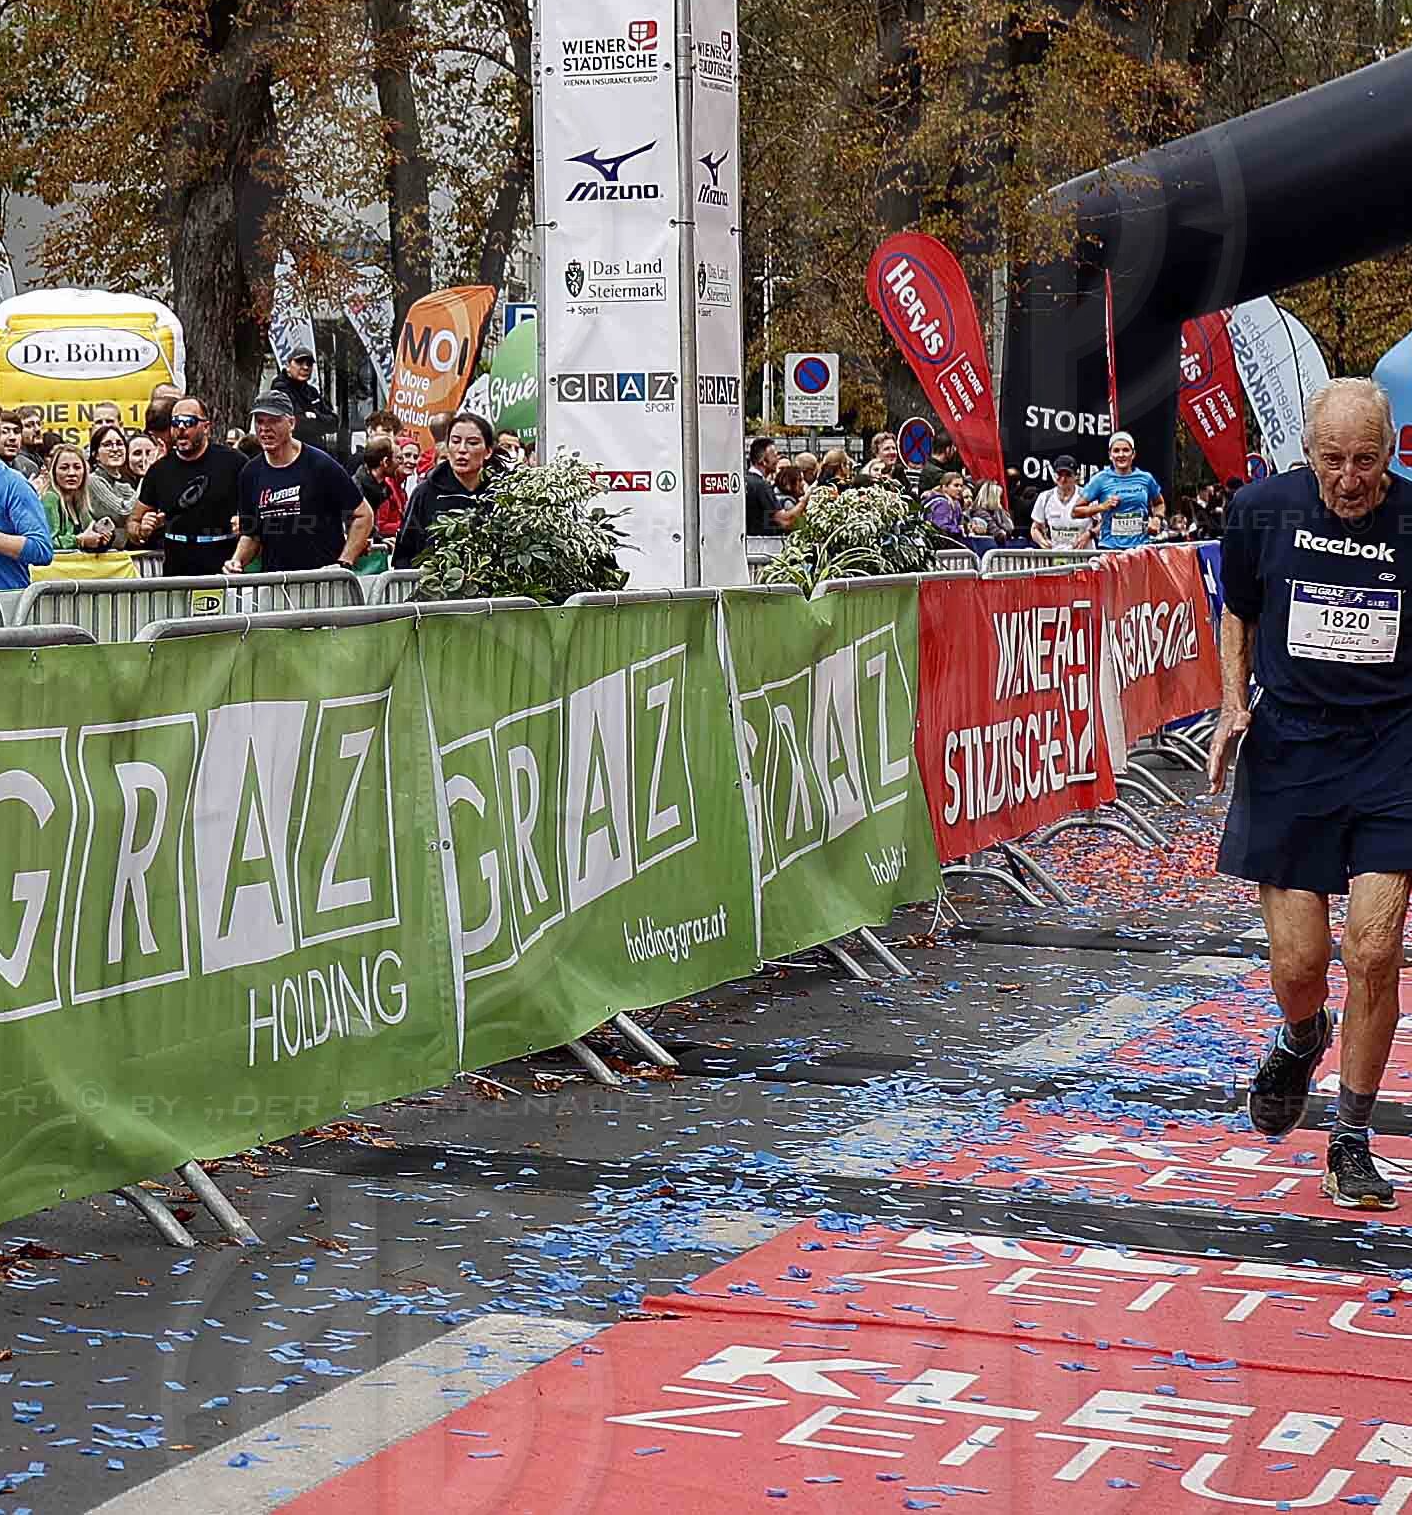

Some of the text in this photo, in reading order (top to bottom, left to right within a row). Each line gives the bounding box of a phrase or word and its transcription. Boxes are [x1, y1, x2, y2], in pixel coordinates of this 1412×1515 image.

[561, 38, 626, 56] WIENER
[562, 52, 658, 72] STÄDTISCHE
[564, 180, 660, 203] MIZUNO
[592, 258, 663, 276] Das Land
[588, 282, 664, 299] Steiermark
[578, 305, 599, 316] Sport
[884, 258, 946, 357] Hervis
[22, 344, 60, 364] Dr.
[401, 323, 470, 376] MOI
[399, 370, 430, 390] Move
[561, 375, 672, 401] GRAZ
[960, 360, 984, 396] STORE
[948, 373, 975, 413] ONLINE
[644, 402, 676, 414] SPORT
[1205, 397, 1227, 432] ONLINE
[1217, 389, 1238, 421] STORE
[1024, 405, 1112, 437] STORE
[704, 475, 729, 493] SPAR
[1293, 529, 1396, 563] Reebok
[1319, 608, 1370, 630] 1820
[247, 948, 408, 1069] HOLDING
